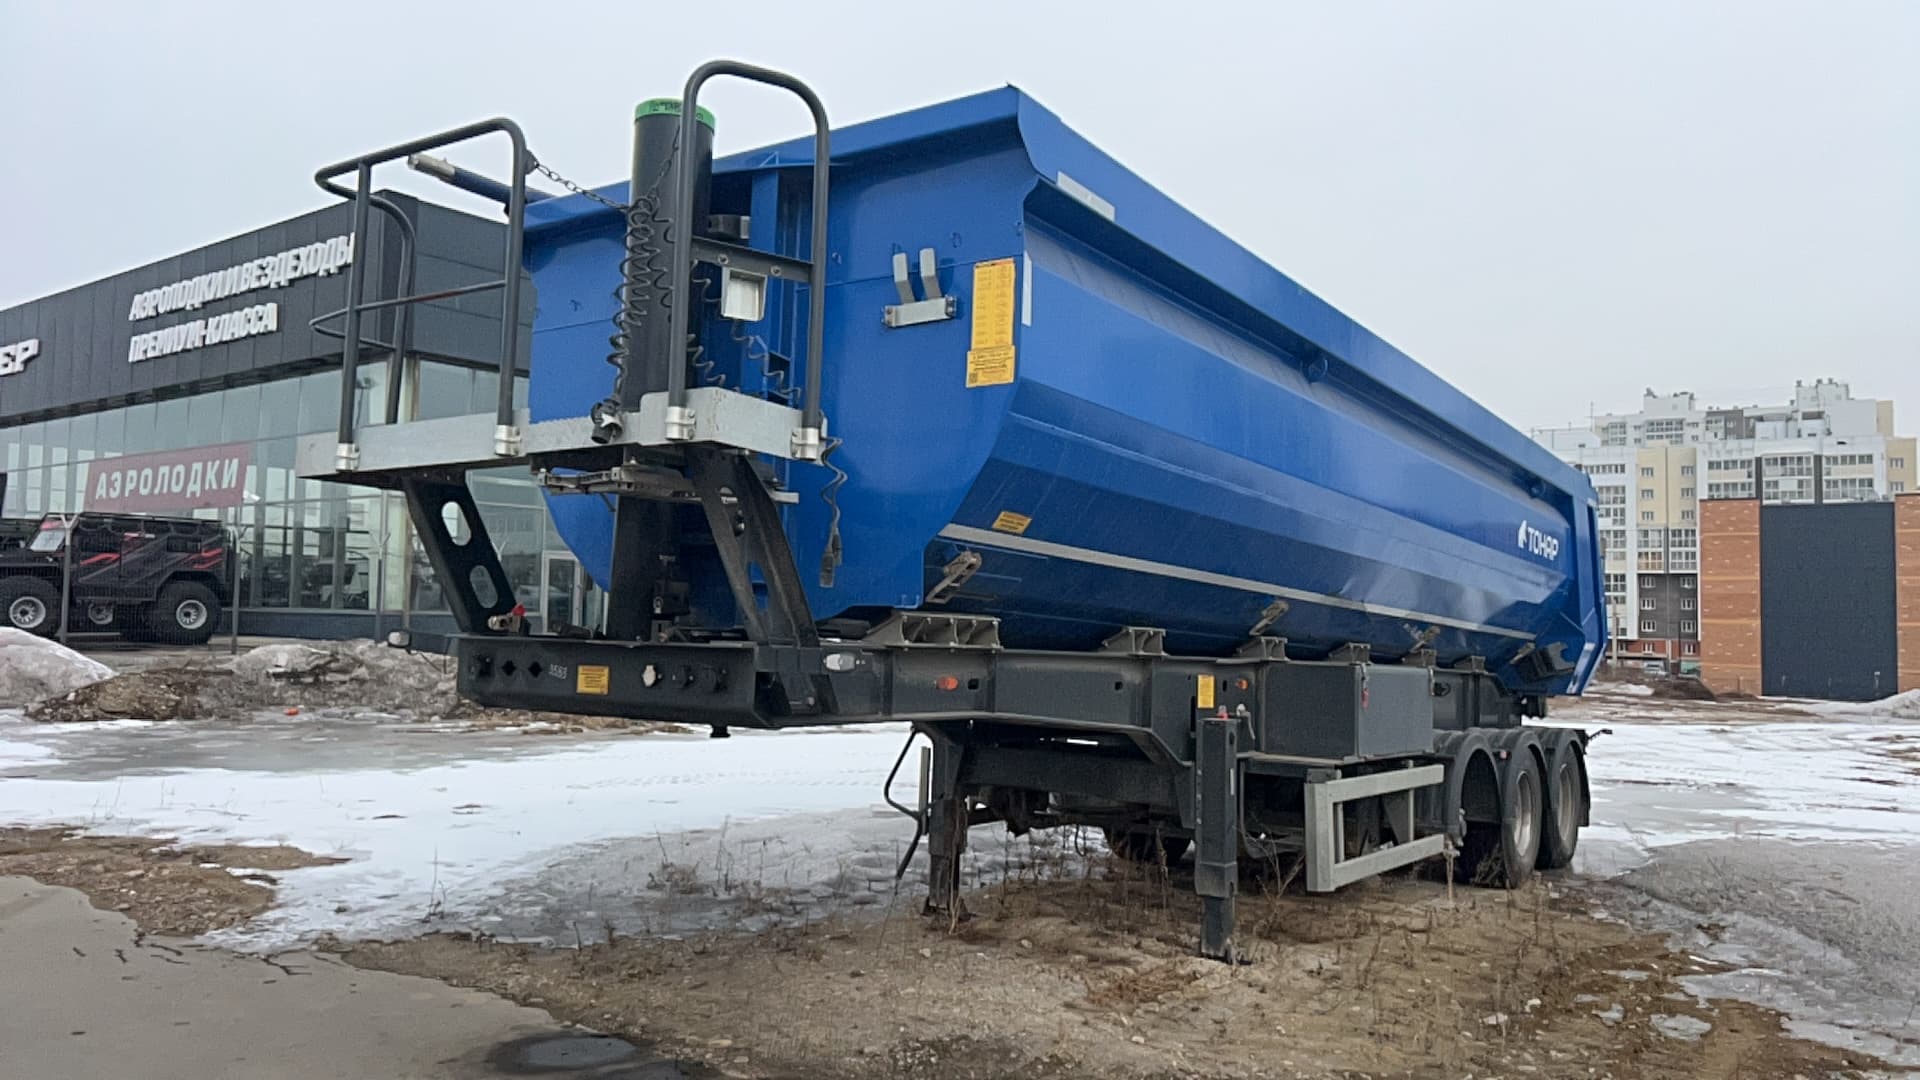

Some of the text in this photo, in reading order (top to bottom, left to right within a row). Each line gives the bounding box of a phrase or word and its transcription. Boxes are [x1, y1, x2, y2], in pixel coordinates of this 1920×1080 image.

[128, 269, 226, 321] АЭРОЛОДКИ
[239, 231, 355, 290] ВЕЗДЕХОДЫ
[128, 302, 278, 363] ПРЕМИУМ-КЛАССА
[95, 458, 239, 500] АЭРОЛОДКИ
[1527, 526, 1560, 561] ТОНАР
